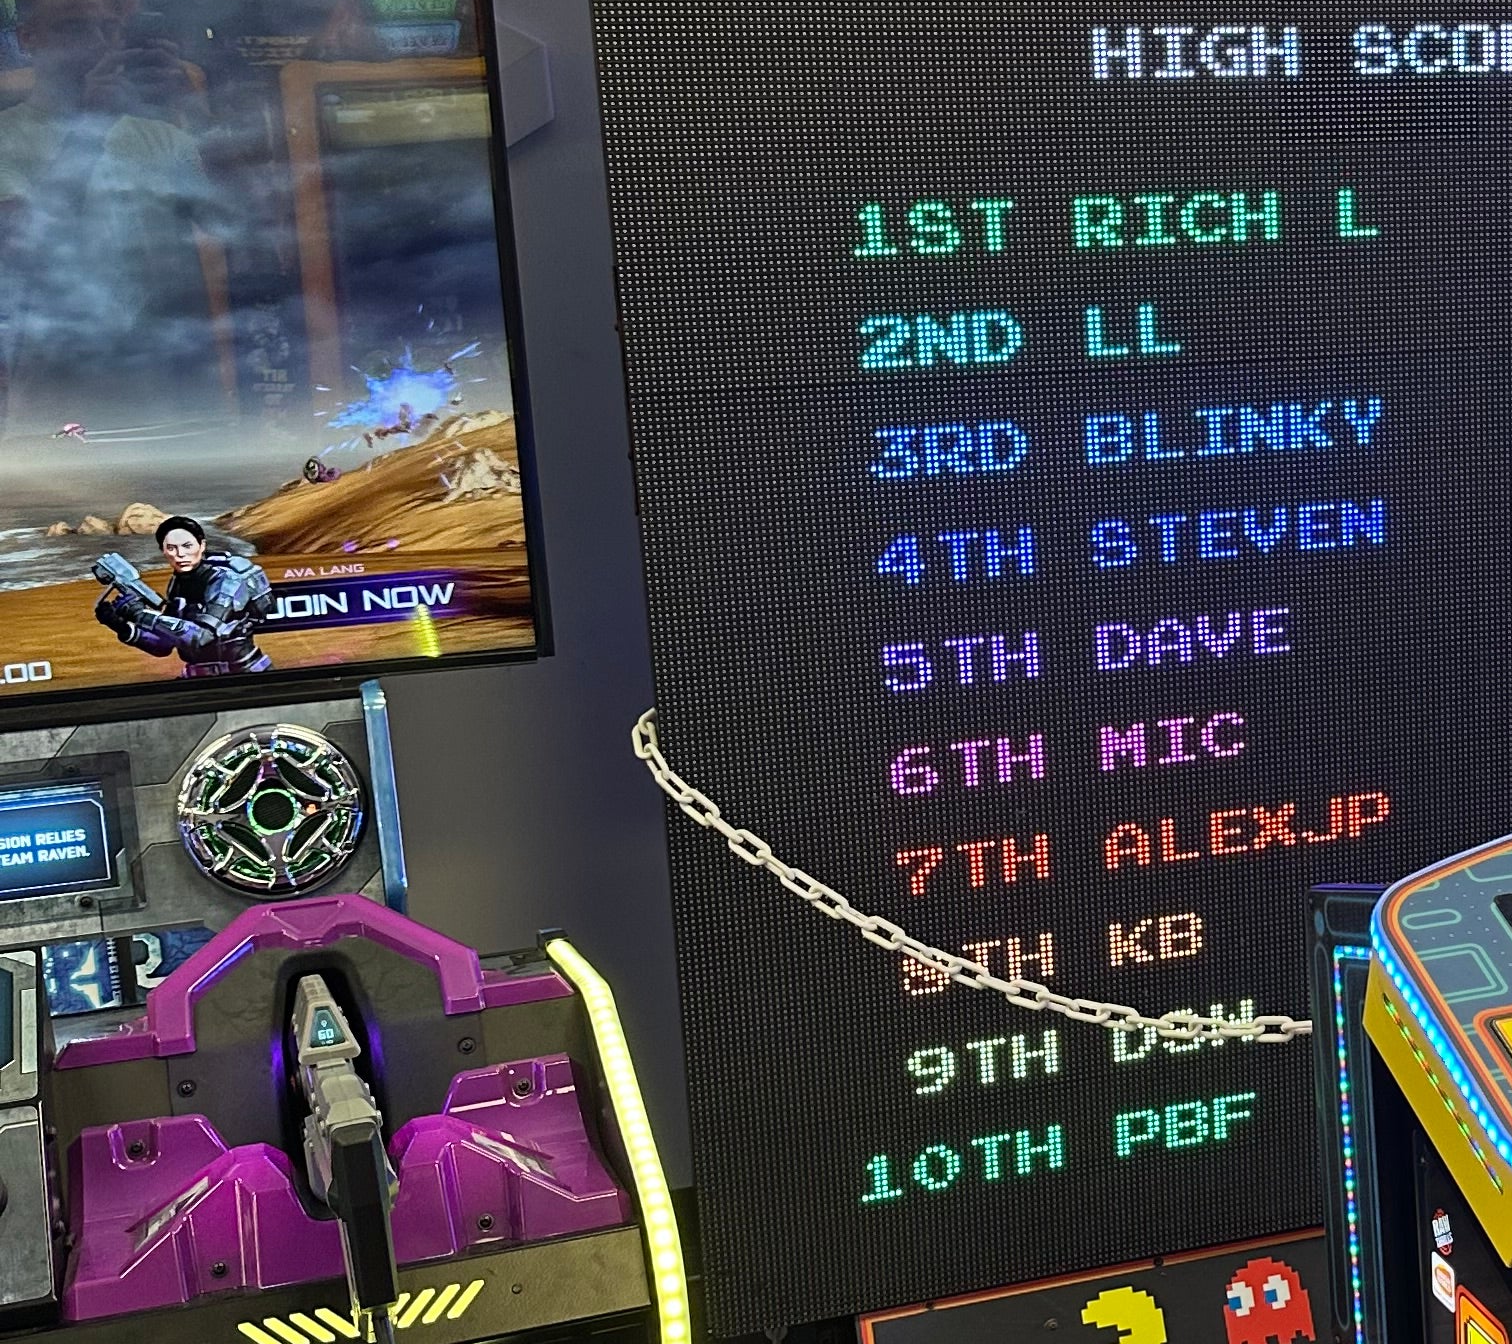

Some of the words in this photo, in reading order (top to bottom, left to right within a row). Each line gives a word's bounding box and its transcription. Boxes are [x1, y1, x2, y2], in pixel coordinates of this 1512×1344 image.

[1092, 24, 1301, 83] HIGH
[854, 197, 1014, 257] 1ST
[1073, 190, 1280, 249] RICH
[1337, 186, 1381, 239] L
[860, 310, 1024, 369] 2ND
[1085, 303, 1183, 358] LL
[870, 420, 1029, 480] 3RD
[1085, 396, 1384, 466] BLINKY
[284, 567, 315, 579] AVA
[319, 564, 365, 576] LANG
[877, 526, 1038, 585] 4TH
[1092, 499, 1386, 570] STEVEN
[266, 591, 349, 620] JOIN
[362, 582, 455, 612] NOW
[882, 630, 1041, 693] 5TH
[1095, 607, 1291, 672] DAVE
[890, 733, 1047, 796] 6TH
[1099, 711, 1247, 773] MIC
[35, 828, 86, 845] RELIES
[37, 845, 91, 862] RAVEN.
[896, 833, 1051, 897] 7TH
[1103, 791, 1392, 871] ALEXJP
[1108, 911, 1205, 968] KB
[906, 1028, 1060, 1096] 9TH
[860, 1124, 1065, 1205] 10TH
[1115, 1091, 1257, 1158] PBF
